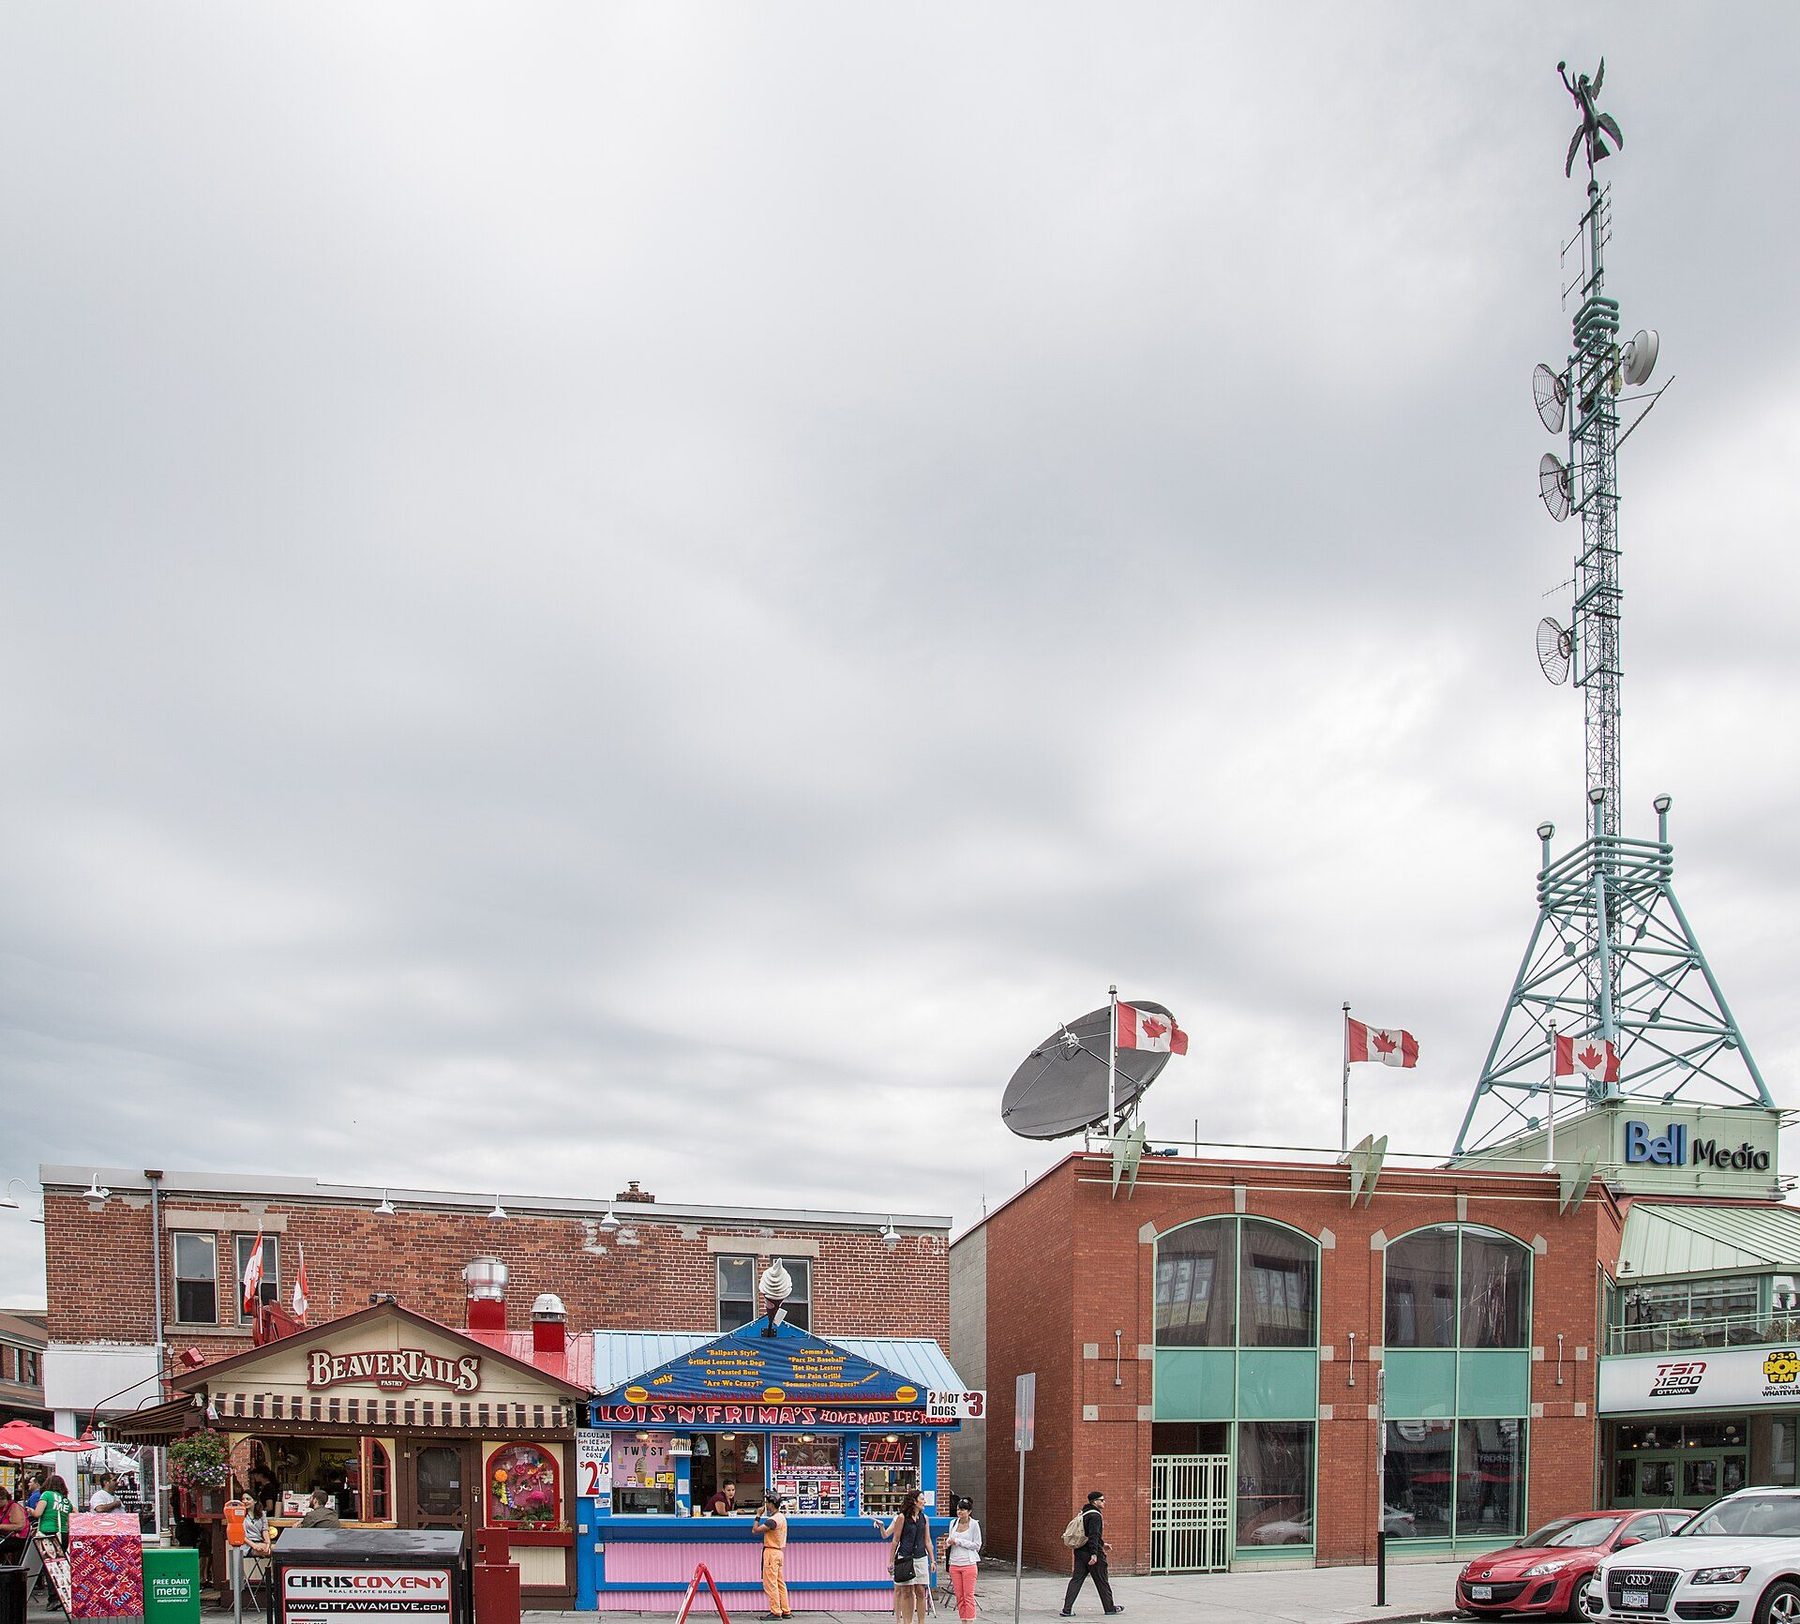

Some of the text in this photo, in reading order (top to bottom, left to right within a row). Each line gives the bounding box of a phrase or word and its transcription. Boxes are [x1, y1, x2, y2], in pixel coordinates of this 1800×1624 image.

[1626, 1120, 1770, 1170] Bell Media
[1656, 1362, 1707, 1376] TSN
[1763, 1360, 1800, 1374] BOB
[652, 1374, 673, 1386] only
[1770, 1374, 1794, 1382] FM
[929, 1392, 960, 1404] 2 HOT
[962, 1392, 984, 1416] $3
[819, 1410, 890, 1425] HOMEMADE
[931, 1406, 956, 1416] DOGS
[864, 1442, 908, 1464] OPEN
[53, 1501, 70, 1513] ME
[156, 1587, 188, 1596] metro
